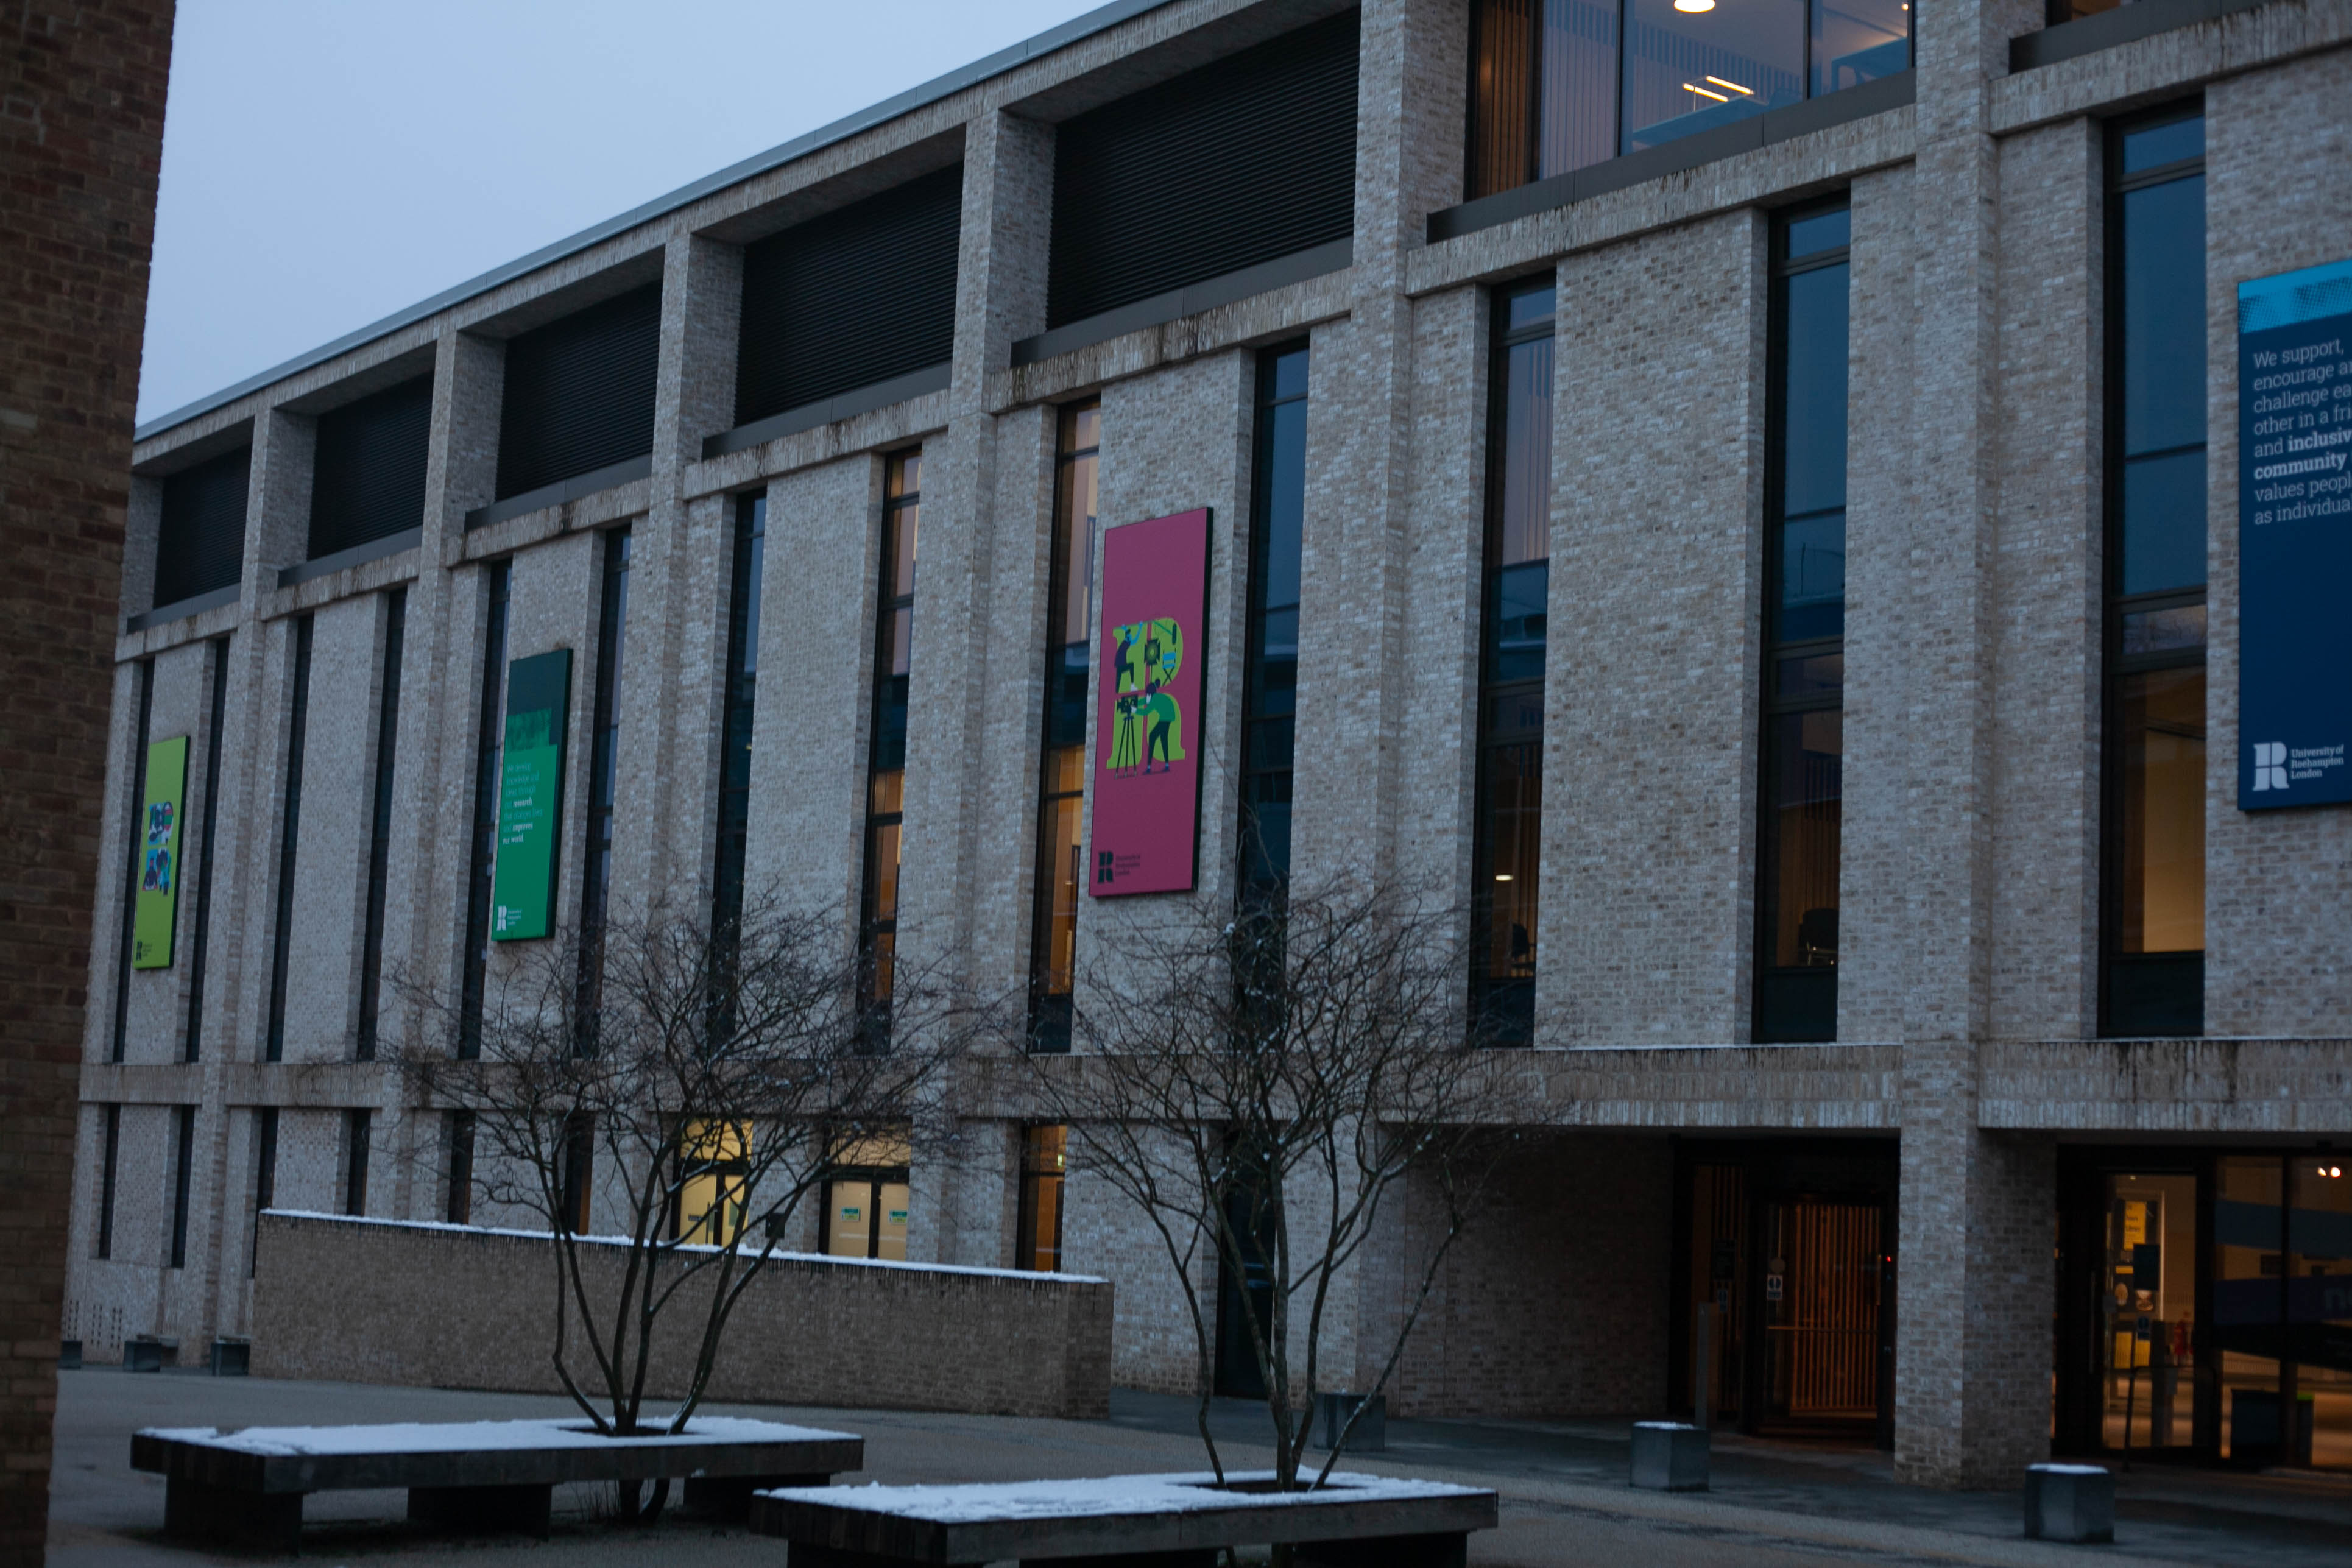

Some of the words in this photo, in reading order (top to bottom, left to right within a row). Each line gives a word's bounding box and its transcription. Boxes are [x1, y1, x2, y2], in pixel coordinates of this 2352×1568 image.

[2253, 351, 2277, 370] We
[2282, 338, 2344, 364] support,
[2253, 364, 2334, 392] encourage
[2253, 387, 2329, 414] challenge
[2254, 415, 2295, 436] other
[2299, 411, 2315, 429] in
[2319, 410, 2329, 425] a
[2254, 437, 2284, 458] and
[2253, 451, 2348, 481] community
[2254, 482, 2305, 503] values
[2254, 509, 2273, 526] as
[2290, 746, 2335, 759] University
[2336, 743, 2344, 755] of
[2290, 756, 2344, 768] Roehampton
[2290, 769, 2323, 780] London
